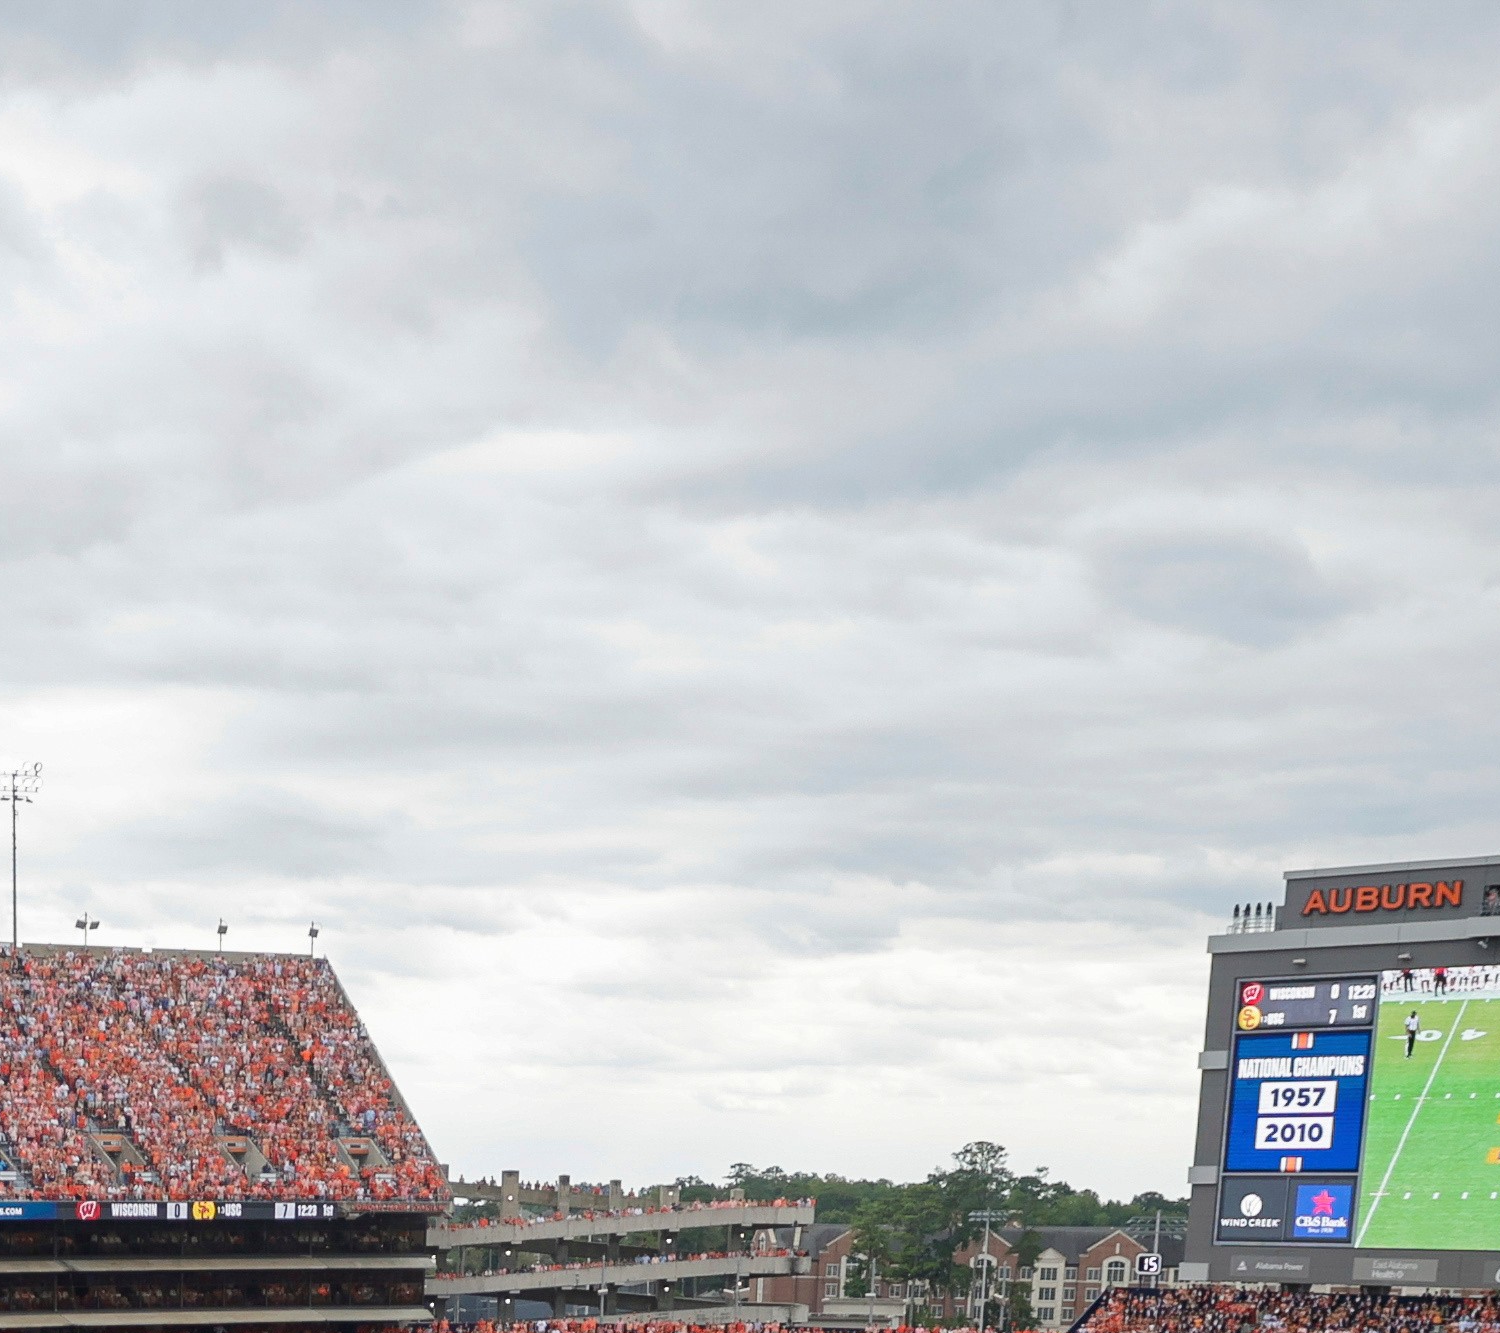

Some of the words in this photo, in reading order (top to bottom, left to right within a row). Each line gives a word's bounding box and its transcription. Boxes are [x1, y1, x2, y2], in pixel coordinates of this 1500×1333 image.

[1302, 880, 1463, 915] AUBURN
[1269, 986, 1316, 1000] WISCONSIN
[1328, 1010, 1338, 1025] 7
[1238, 1057, 1292, 1079] NATIONAL
[1293, 1055, 1365, 1078] CHAMPIONS
[1270, 1087, 1326, 1108] 1957
[1264, 1122, 1323, 1143] 2010
[111, 1203, 157, 1217] WISCONSIN
[225, 1203, 242, 1217] USC
[297, 1204, 317, 1217] 12:23
[1221, 1218, 1247, 1228] WIND
[1248, 1217, 1279, 1228] CREEK
[1144, 1257, 1158, 1272] 15
